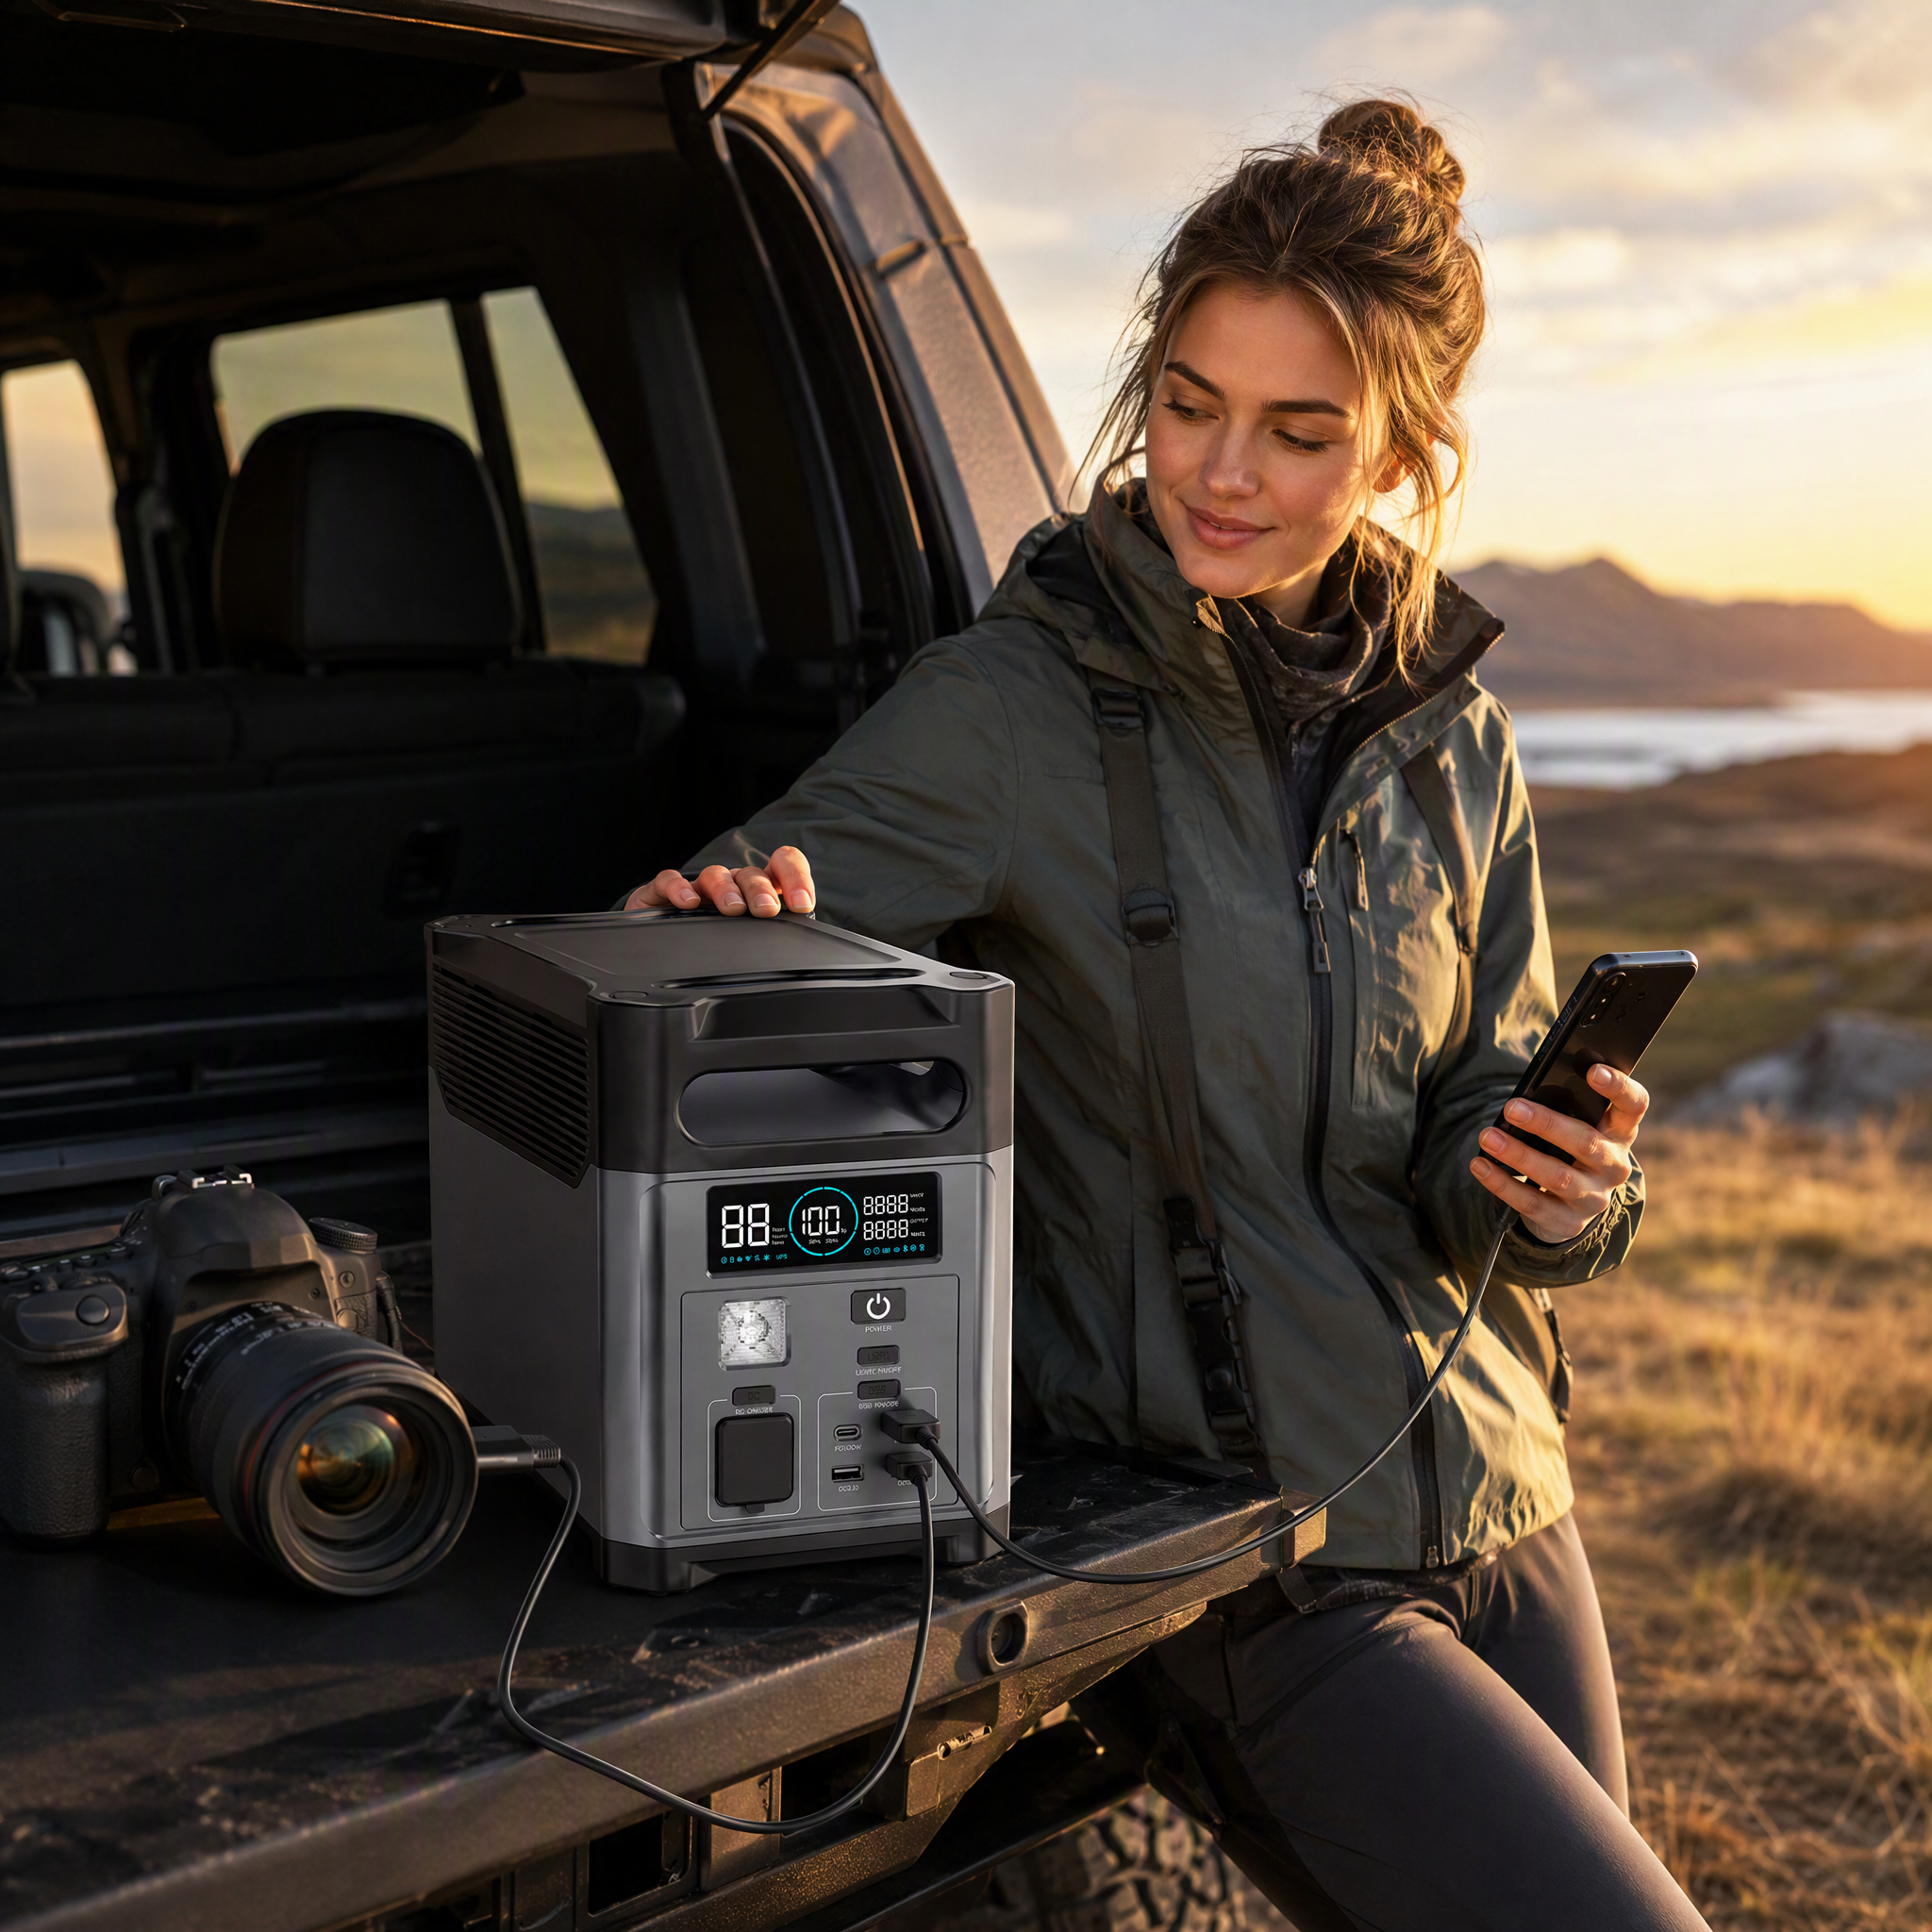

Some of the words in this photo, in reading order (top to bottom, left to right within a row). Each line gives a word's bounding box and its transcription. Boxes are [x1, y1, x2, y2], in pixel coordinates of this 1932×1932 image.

[863, 1193, 908, 1215] 8888
[722, 1203, 770, 1248] 88
[801, 1205, 841, 1237] 100
[863, 1219, 908, 1241] 8888
